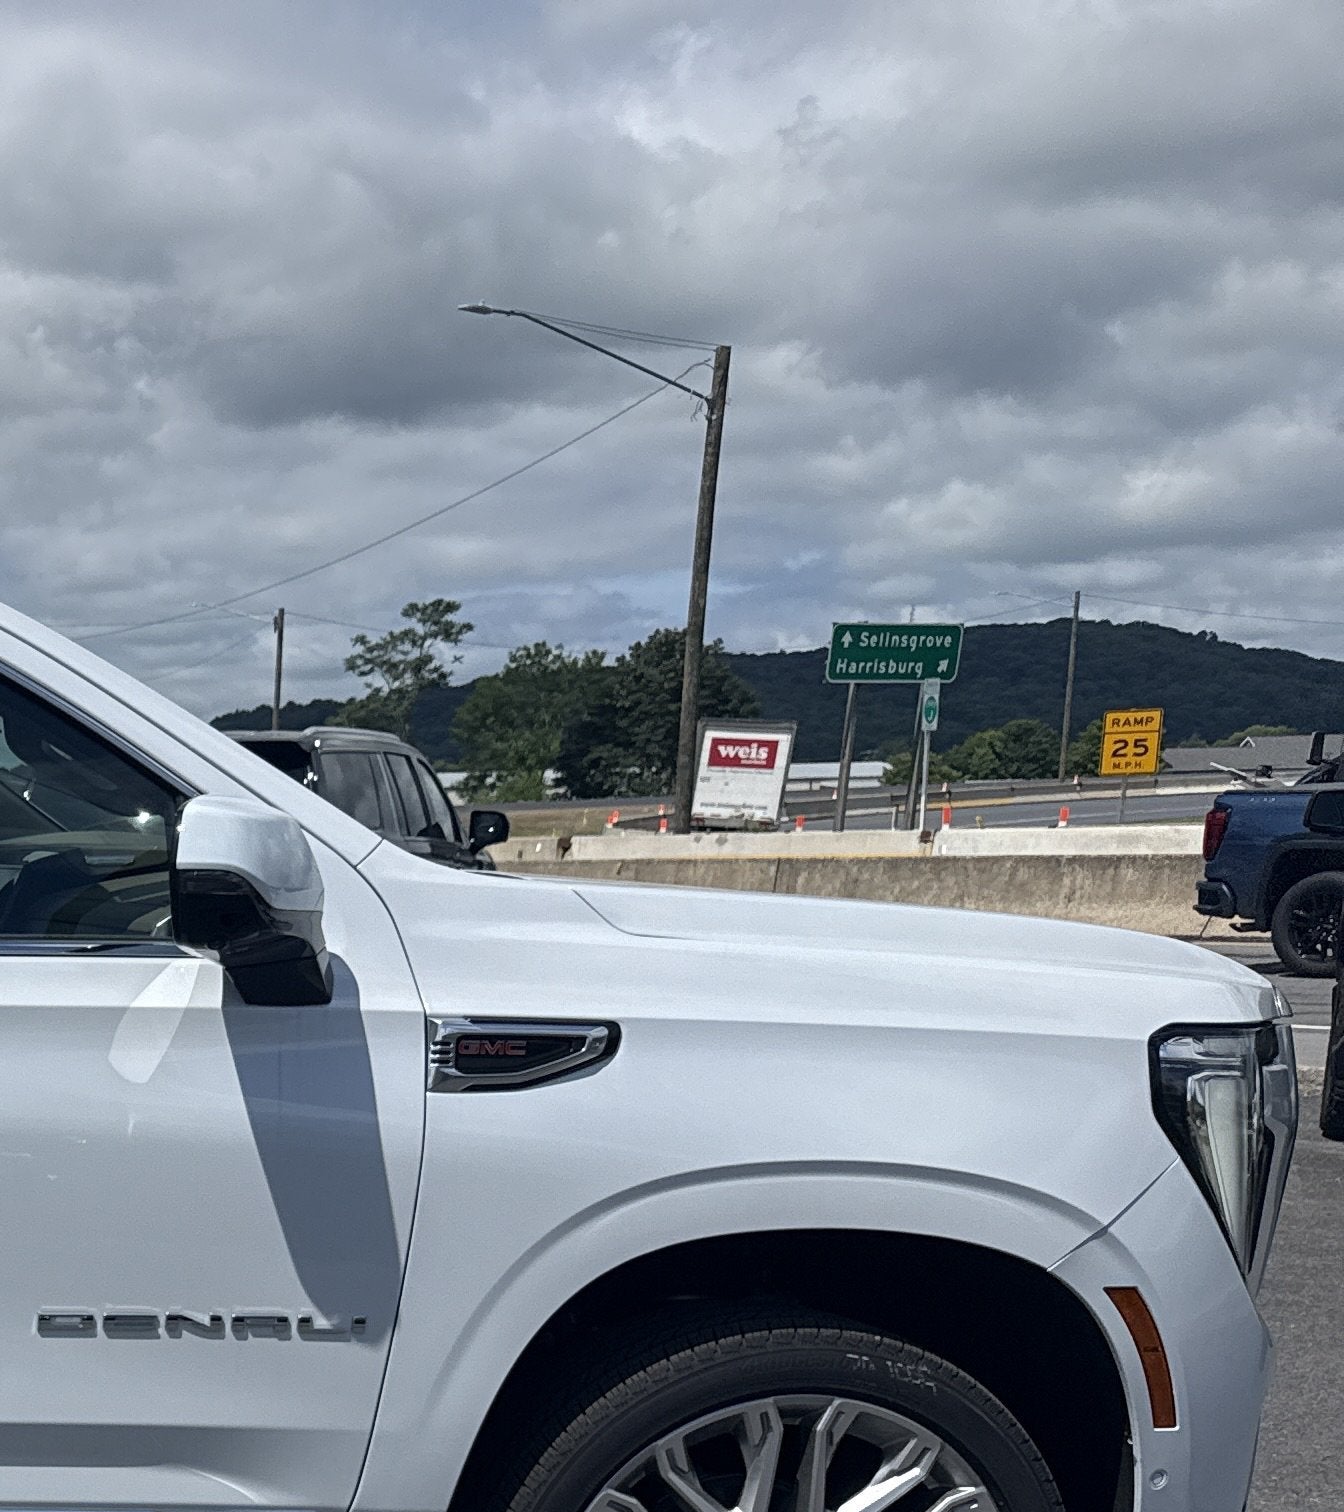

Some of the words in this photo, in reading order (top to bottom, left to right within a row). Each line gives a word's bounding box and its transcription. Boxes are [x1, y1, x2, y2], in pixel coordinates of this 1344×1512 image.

[859, 631, 953, 652] Selinsgrove
[835, 658, 924, 678] Harrisburg
[1111, 716, 1155, 728] RAMP
[717, 742, 769, 760] weis
[1111, 738, 1149, 758] 25
[458, 1039, 528, 1056] GMC
[32, 1305, 368, 1341] DENALI
